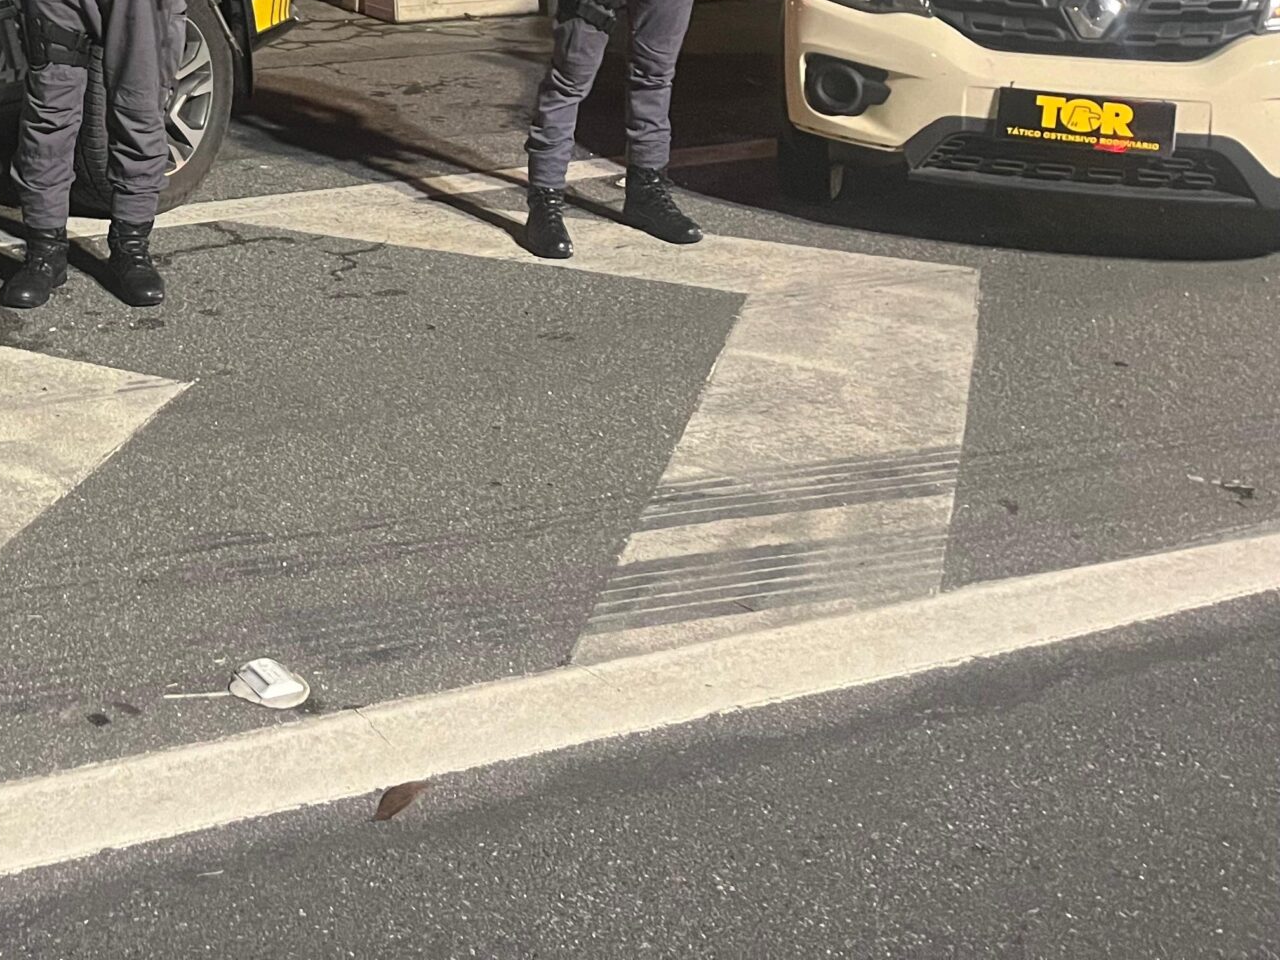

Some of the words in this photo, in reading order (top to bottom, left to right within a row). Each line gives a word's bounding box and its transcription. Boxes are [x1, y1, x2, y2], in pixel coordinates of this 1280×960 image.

[1035, 94, 1134, 137] TOR
[1007, 126, 1041, 138] TÁTICO
[1043, 131, 1098, 144] OSTENSIVO
